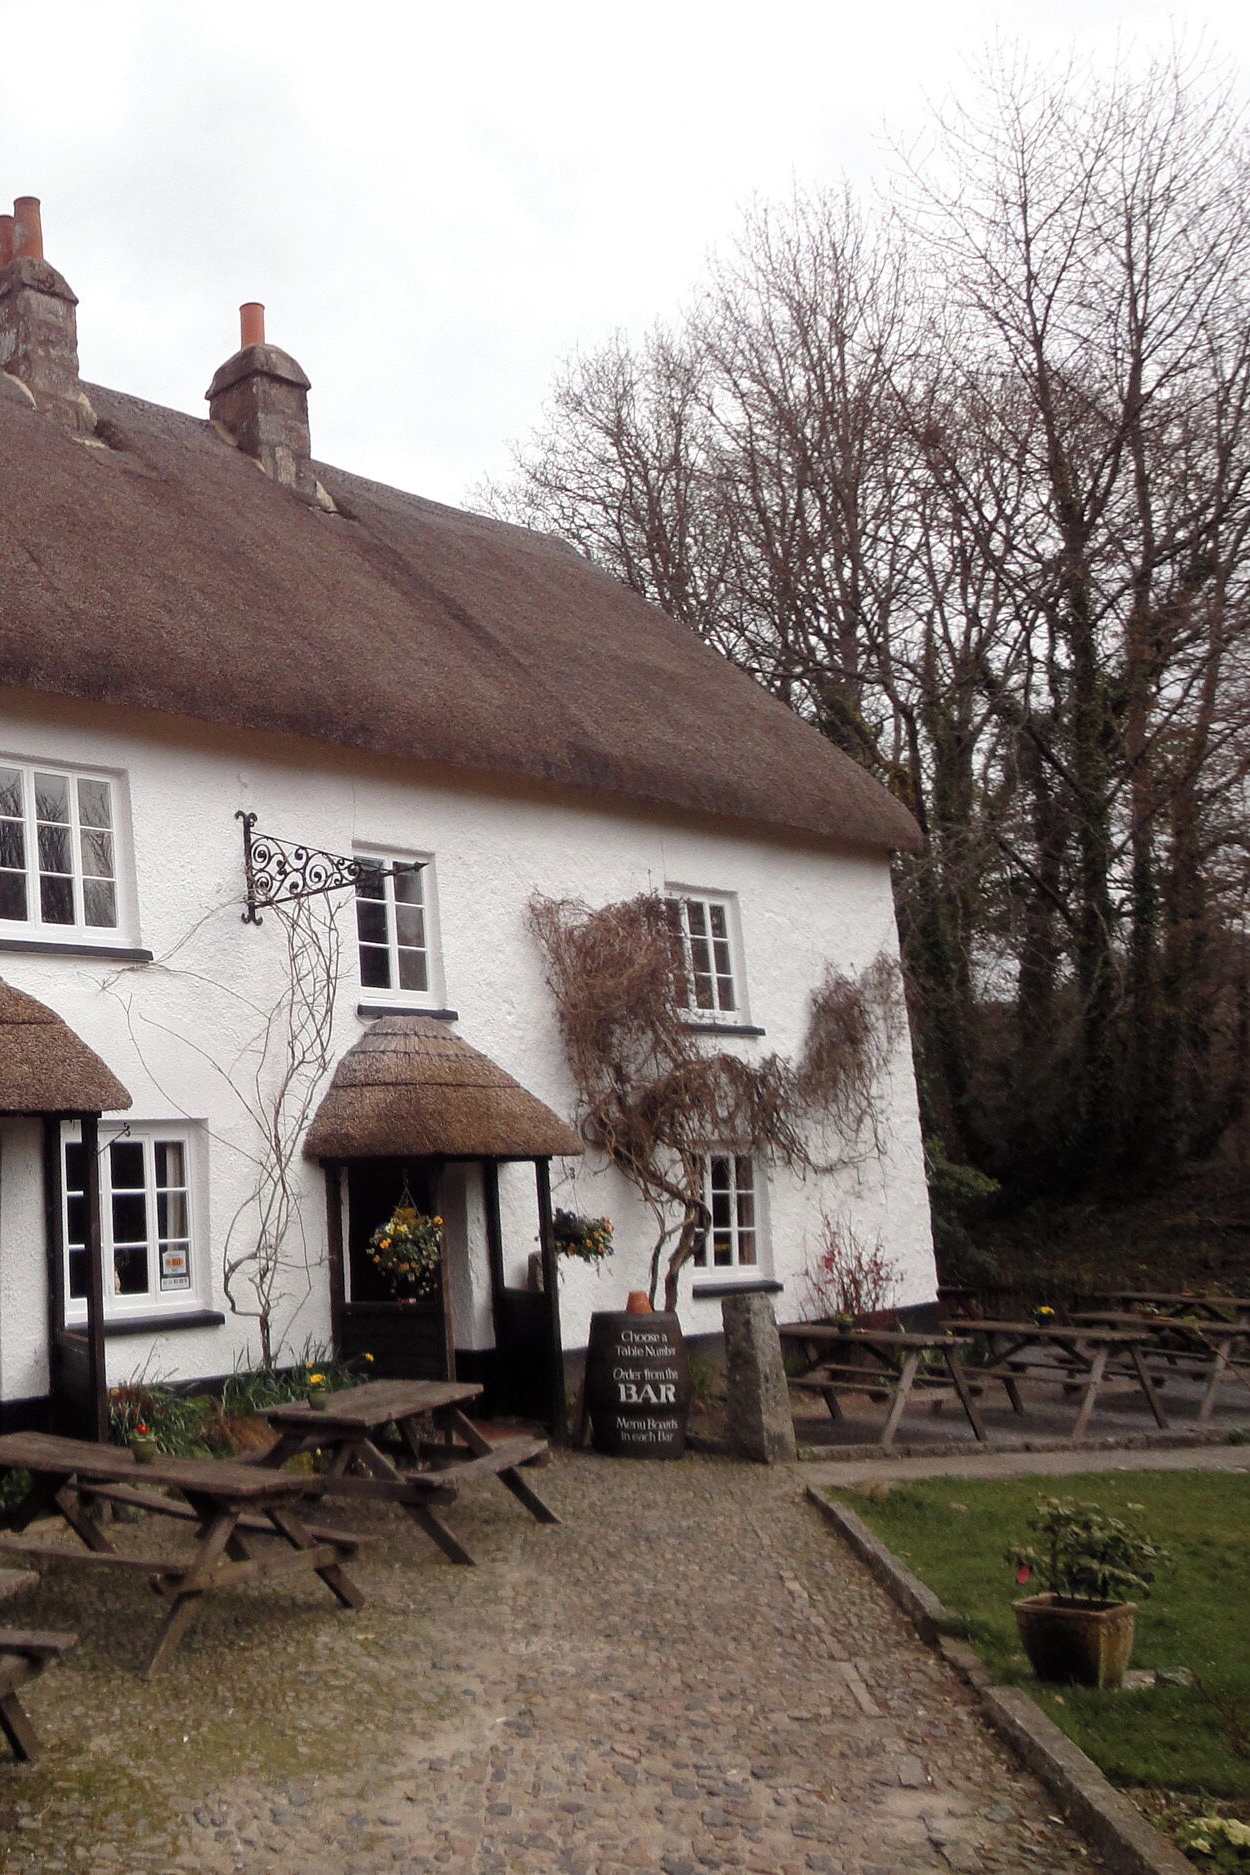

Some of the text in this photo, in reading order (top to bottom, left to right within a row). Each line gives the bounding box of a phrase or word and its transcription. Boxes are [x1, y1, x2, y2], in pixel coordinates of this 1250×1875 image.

[621, 1330, 668, 1343] Choose a
[616, 1345, 676, 1357] Table Number
[613, 1367, 678, 1380] Order from the
[618, 1383, 676, 1403] BAR
[616, 1416, 678, 1430] Menu Boards
[632, 1430, 656, 1442] each
[658, 1429, 674, 1442] Bar
